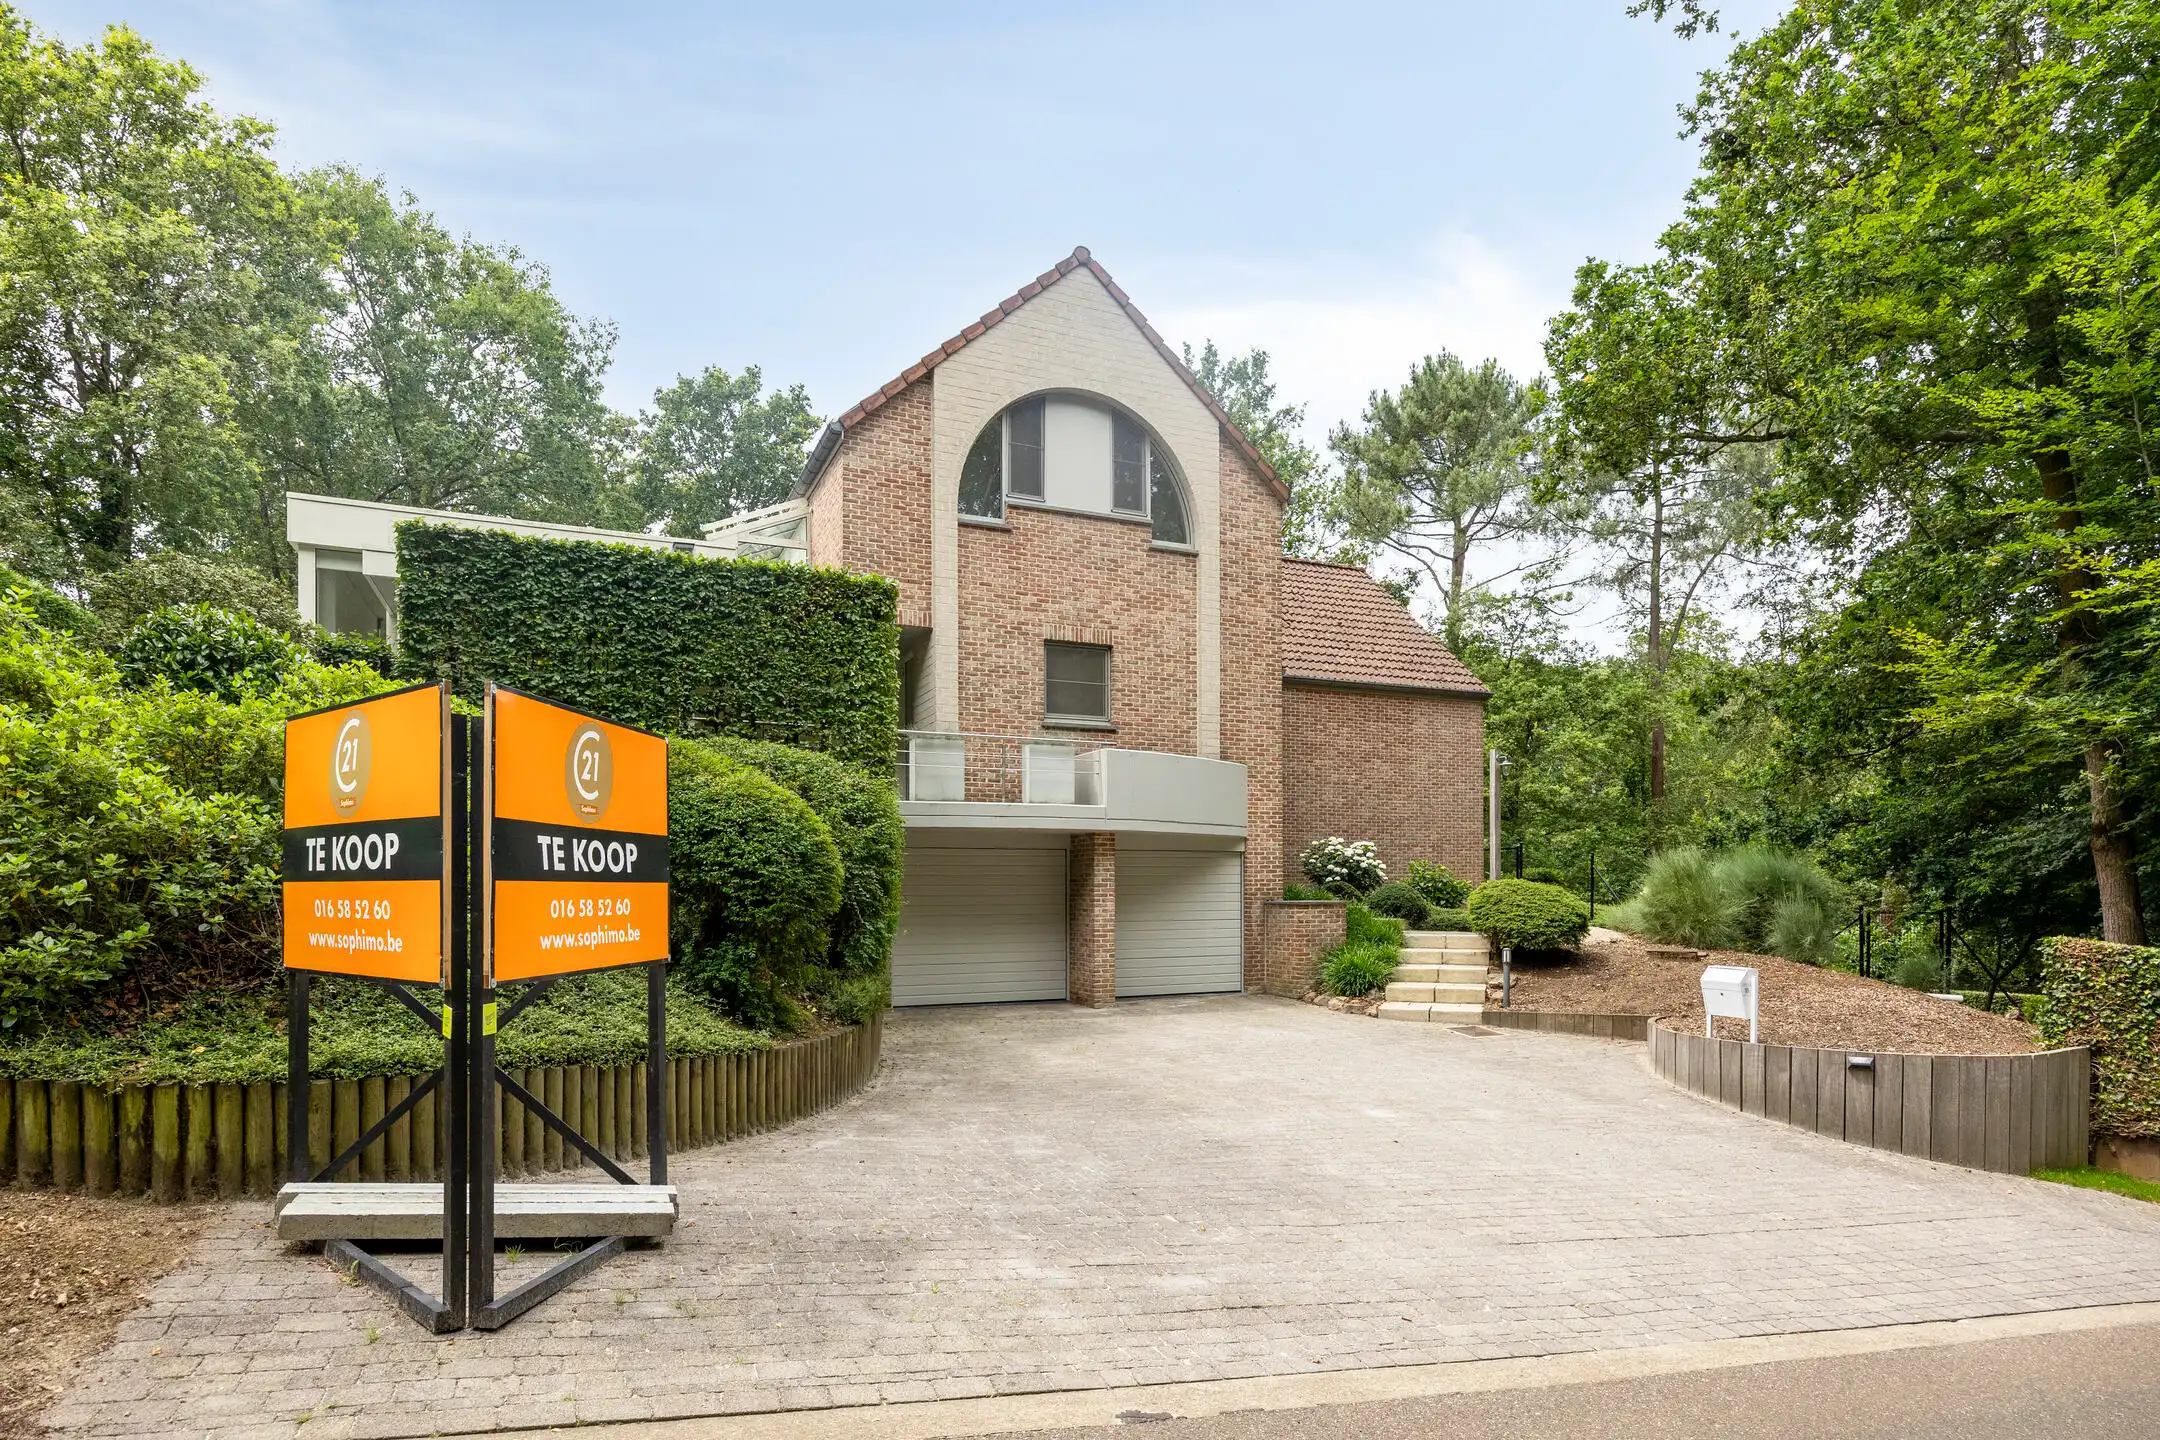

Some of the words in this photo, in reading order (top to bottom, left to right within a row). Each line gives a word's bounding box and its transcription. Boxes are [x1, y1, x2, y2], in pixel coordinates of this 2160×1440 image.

[306, 837, 326, 872] TE
[332, 832, 400, 872] KOOP
[537, 835, 566, 872] TE
[573, 838, 638, 873] KOOP
[314, 899, 335, 918] 016
[337, 899, 351, 919] 58
[355, 900, 369, 919] 52
[373, 900, 391, 920] 60
[550, 900, 575, 918] 016
[579, 899, 594, 917] 58
[597, 899, 613, 916] 52
[615, 898, 631, 916] 60
[308, 929, 403, 954] www.sophimo.be
[539, 923, 641, 950] www.sophimo.be
